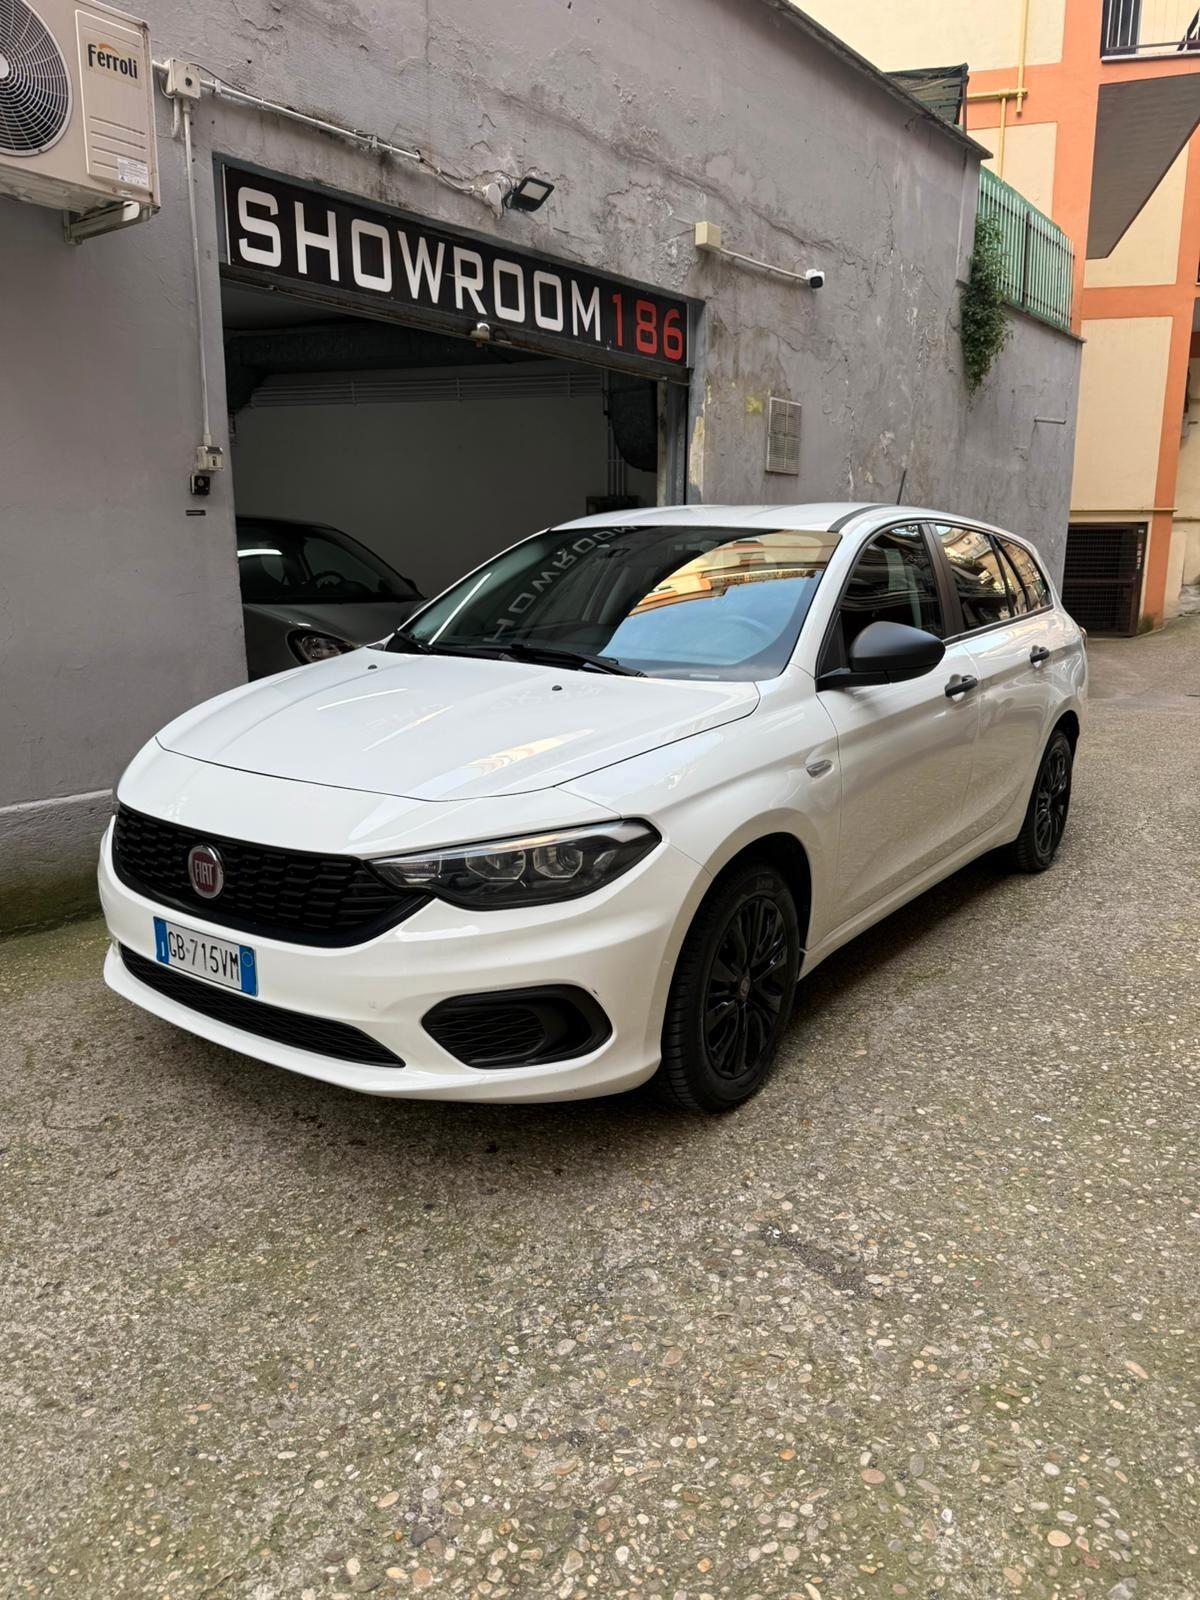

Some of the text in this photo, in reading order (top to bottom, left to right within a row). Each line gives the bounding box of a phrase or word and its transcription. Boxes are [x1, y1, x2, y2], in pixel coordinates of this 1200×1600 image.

[87, 43, 138, 80] Ferroli
[237, 186, 683, 361] SHOWROOM 186
[193, 860, 214, 886] FIAT
